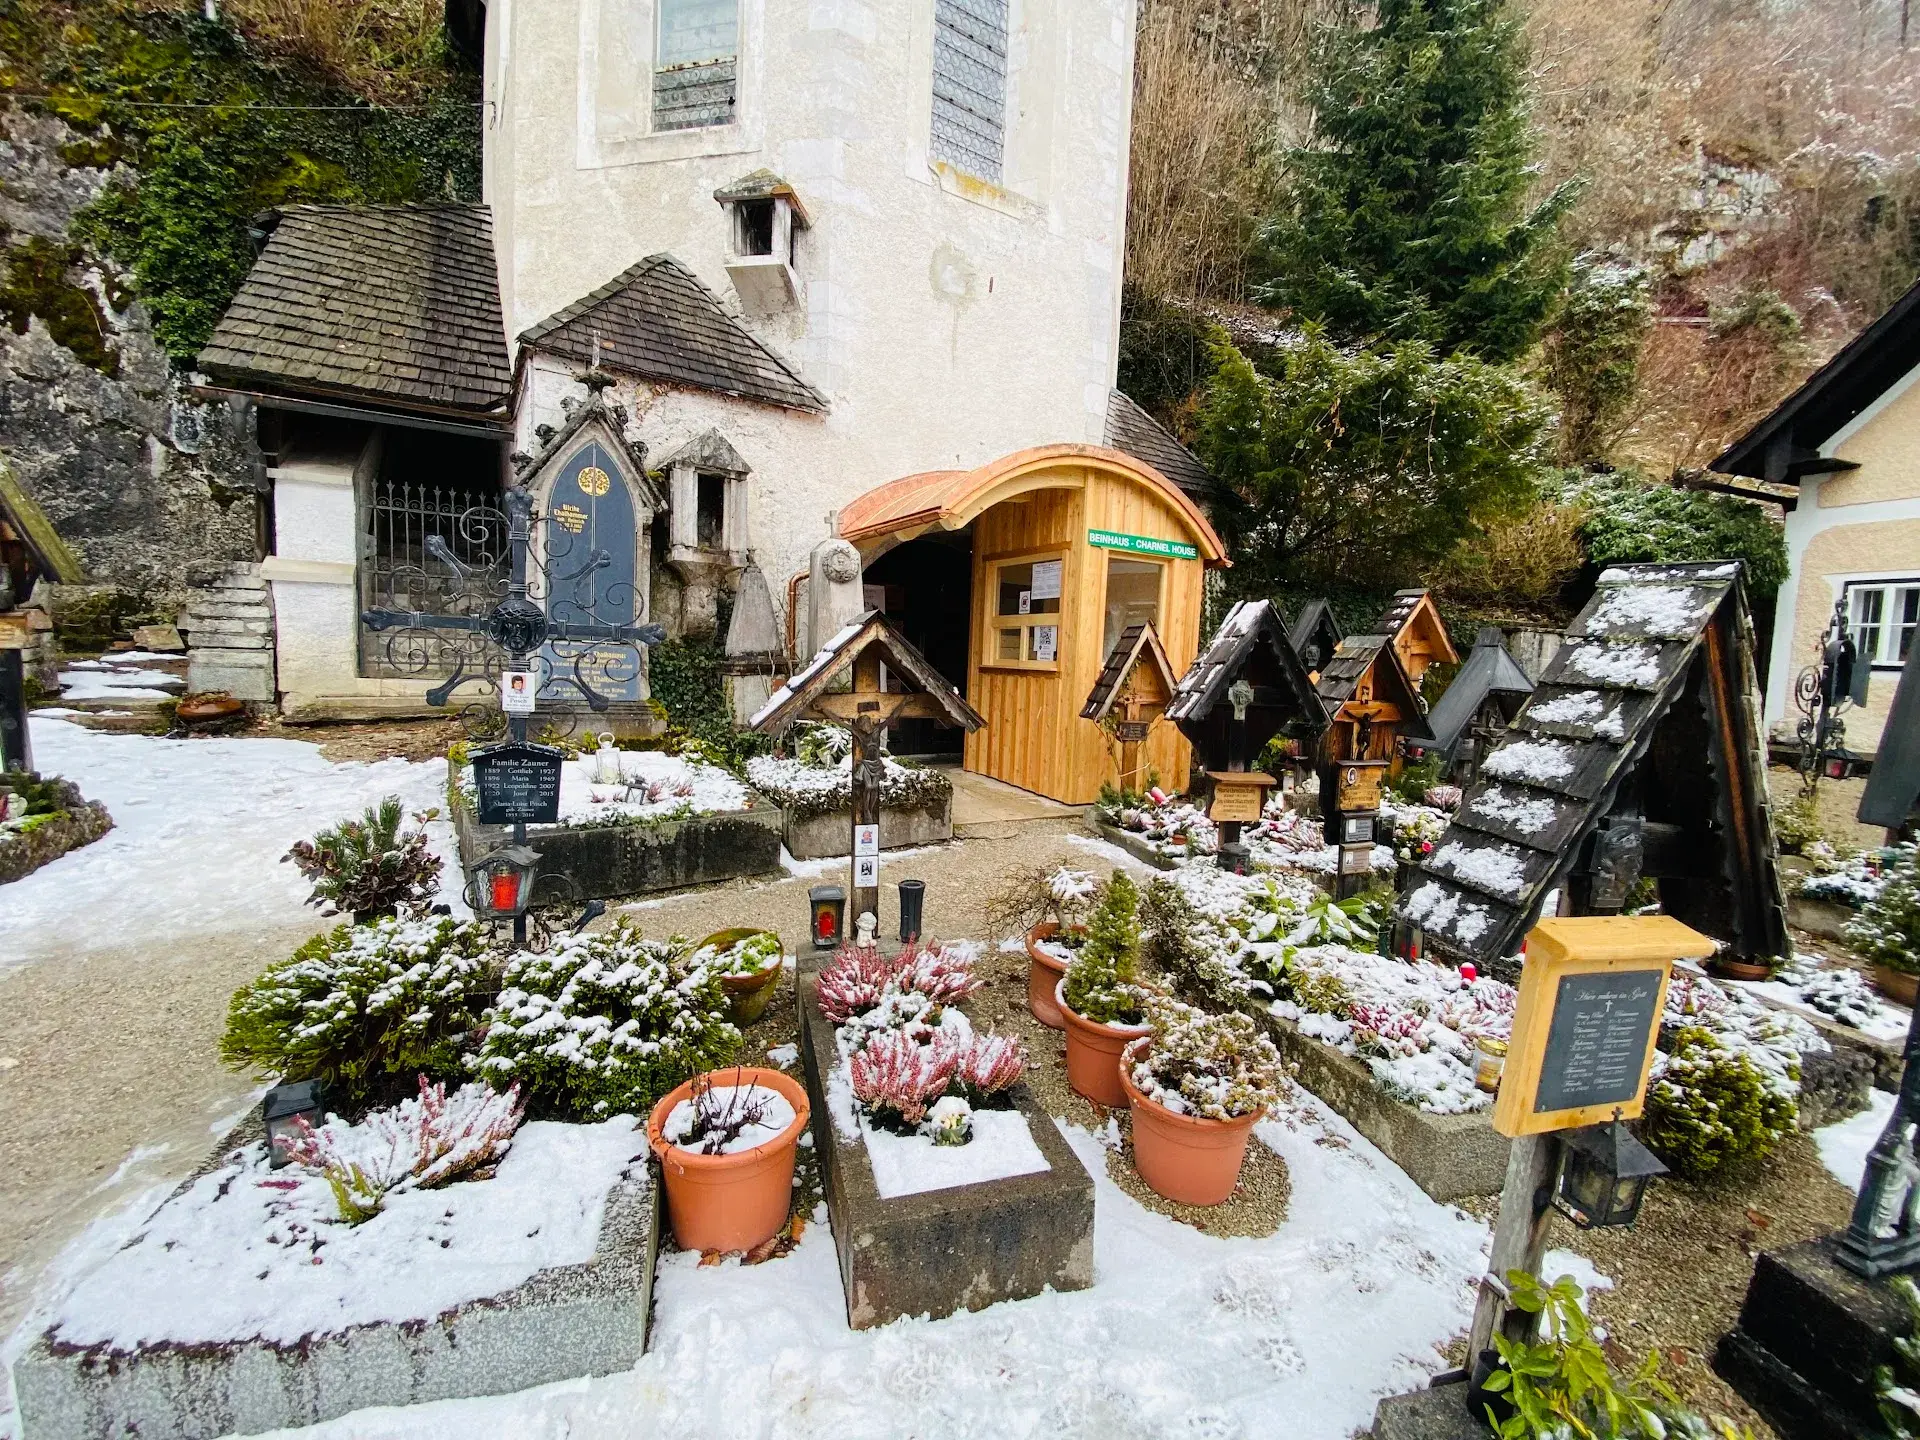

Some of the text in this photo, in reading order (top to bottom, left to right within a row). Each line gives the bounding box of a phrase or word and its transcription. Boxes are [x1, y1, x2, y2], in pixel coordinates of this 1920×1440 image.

[1089, 532, 1130, 547] BEINHAUS
[1135, 539, 1171, 552] CHARNEL
[1171, 545, 1197, 557] HOUSE
[491, 758, 548, 767] Familie Zauner
